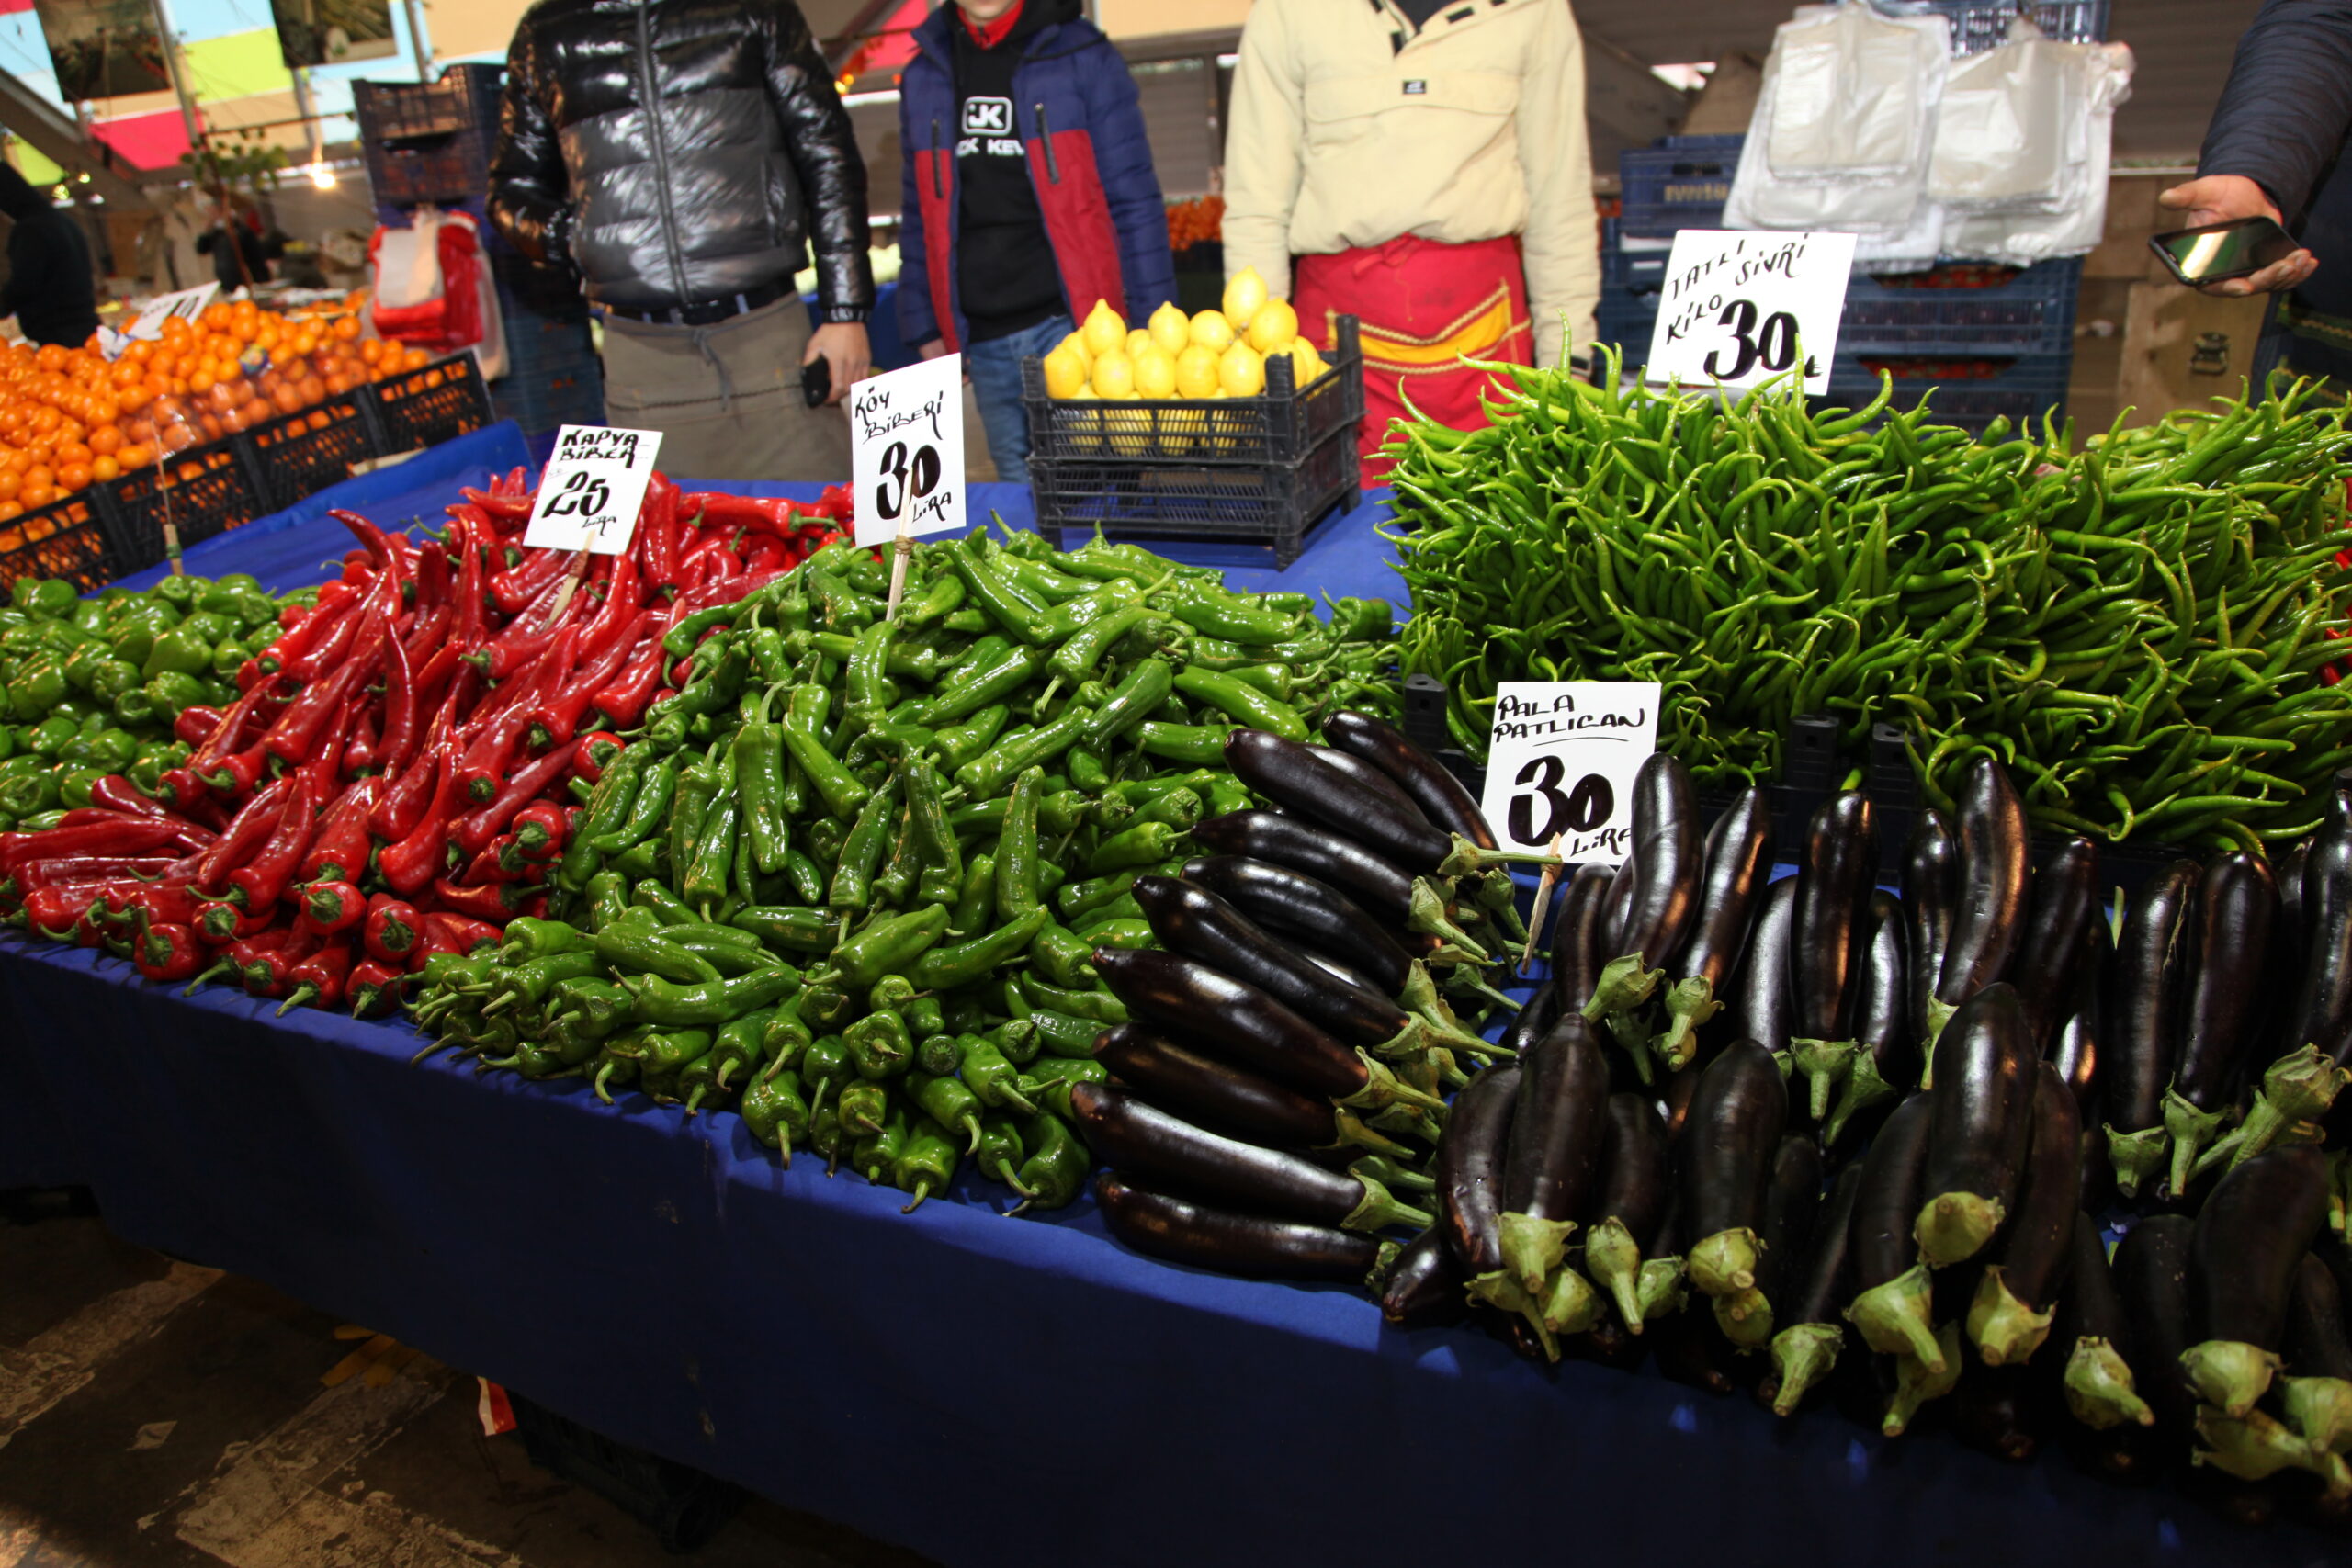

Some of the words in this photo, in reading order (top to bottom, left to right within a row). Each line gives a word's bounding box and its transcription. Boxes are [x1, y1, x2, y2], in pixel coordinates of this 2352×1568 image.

[1702, 299, 1801, 381] 30
[561, 428, 639, 447] KAPYA
[540, 470, 610, 519] 25
[876, 440, 942, 521] 30
[1493, 707, 1645, 743] PATLICAN
[1498, 694, 1576, 722] PALA
[1507, 754, 1615, 848] 30
